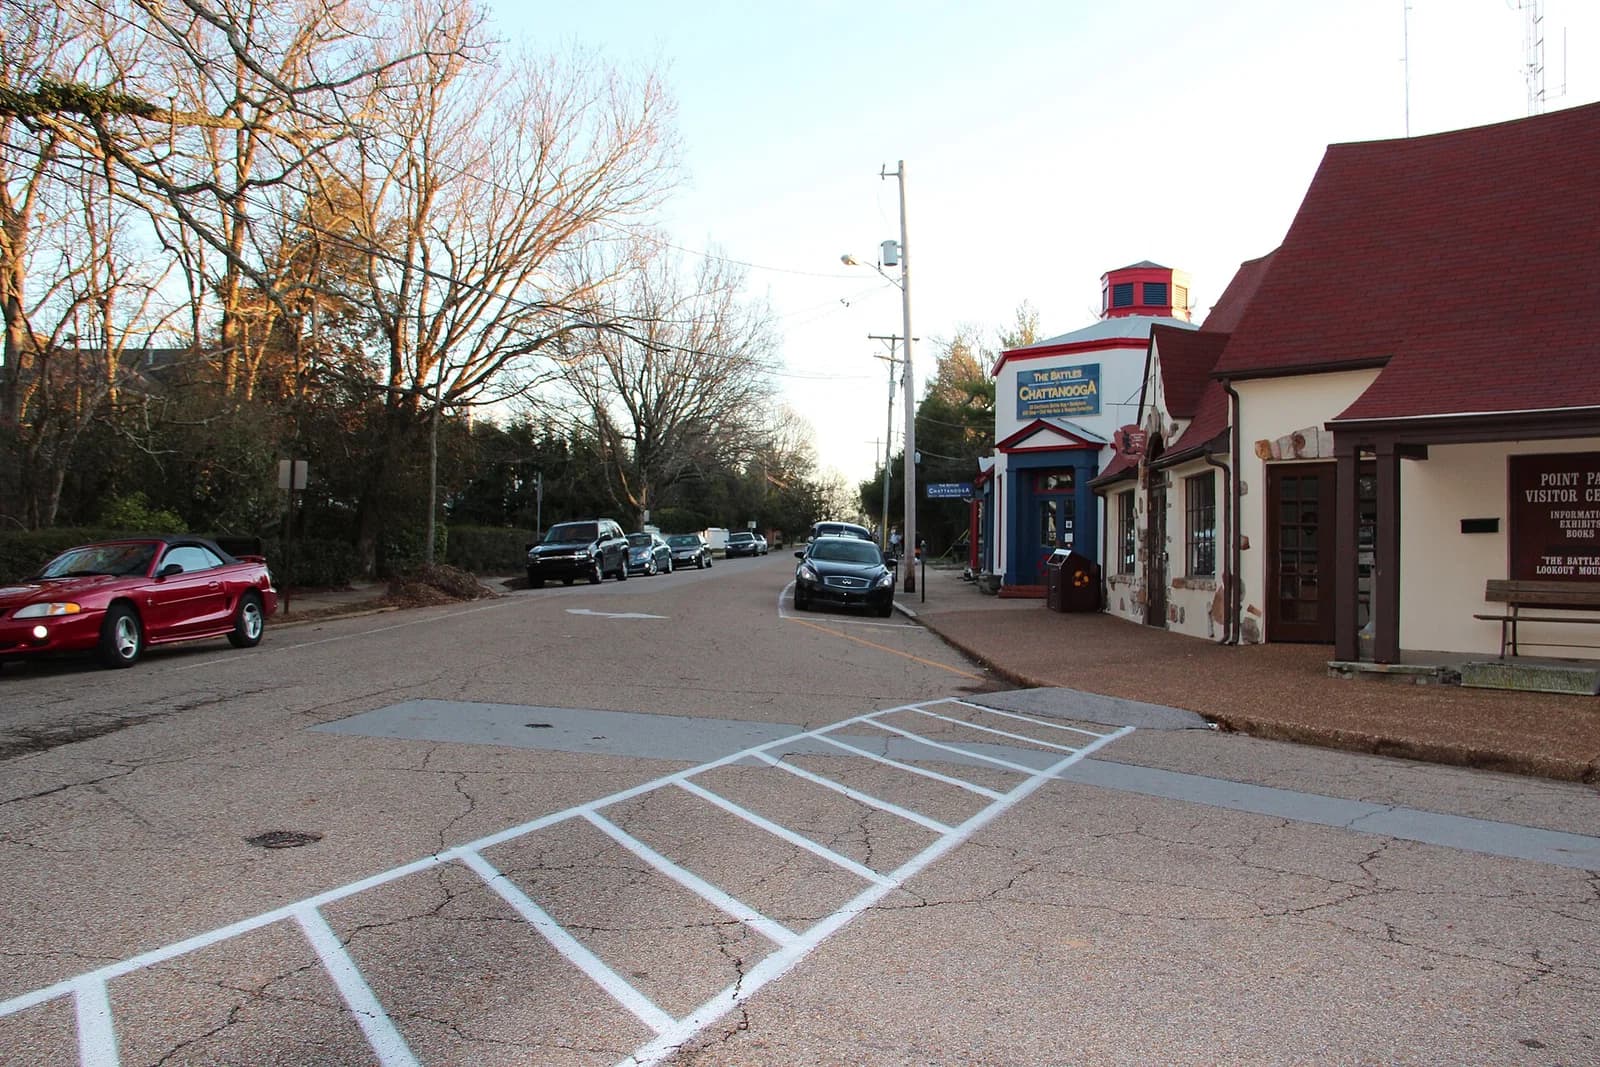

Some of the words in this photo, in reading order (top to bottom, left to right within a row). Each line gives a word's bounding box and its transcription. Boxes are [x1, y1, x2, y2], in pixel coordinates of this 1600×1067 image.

[1034, 373, 1048, 382] THE
[1020, 381, 1095, 400] CHATTANOOGA
[1541, 473, 1579, 486] POINT
[1526, 490, 1577, 502] VISITOR
[1586, 489, 1600, 502] CE
[1550, 511, 1600, 519] INFORMATI
[1559, 519, 1600, 528] EXHIBITS
[1567, 530, 1594, 538] BOOKS
[1567, 556, 1600, 565] BATTLE
[1536, 566, 1575, 575] LOOKOUT
